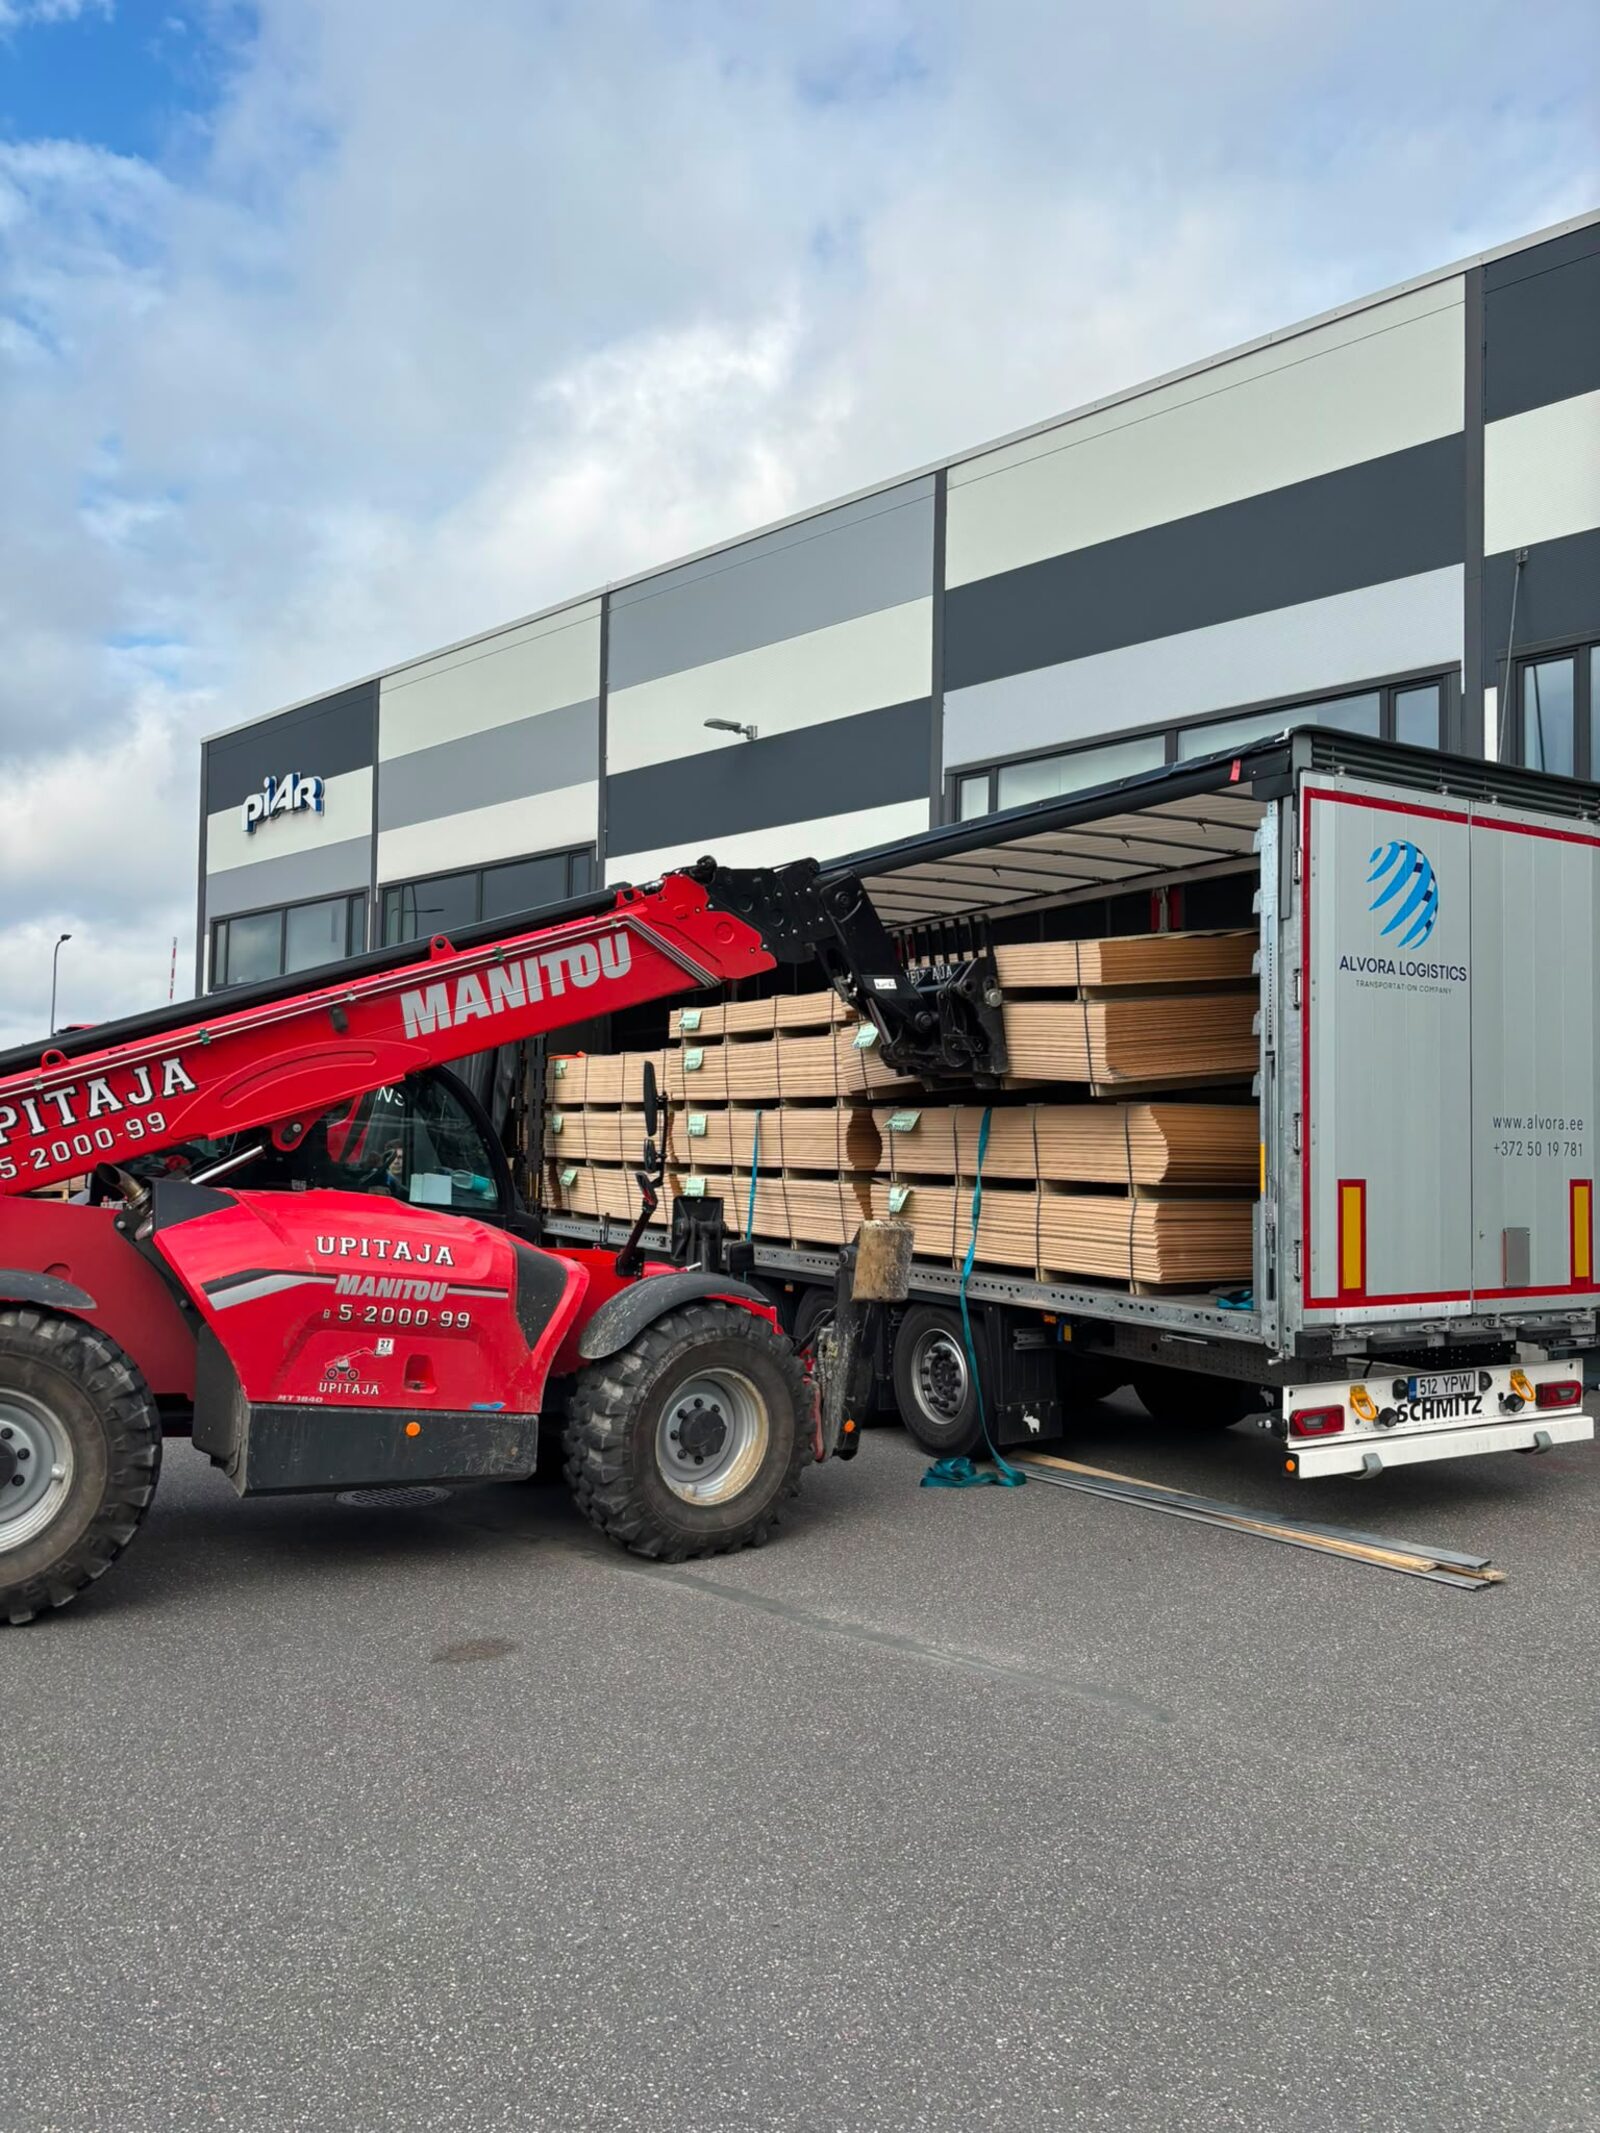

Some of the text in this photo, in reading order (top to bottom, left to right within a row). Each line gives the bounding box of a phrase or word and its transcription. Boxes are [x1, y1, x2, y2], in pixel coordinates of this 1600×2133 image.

[1339, 955, 1467, 982] ALVORA LOGISTICS
[400, 931, 633, 1040] MANITOU
[1419, 985, 1452, 995] COMPANY
[1493, 1114, 1584, 1131] www.alvora.ee
[0, 1111, 167, 1180] 5-2000-99
[1493, 1140, 1583, 1157] +372 50 19 781
[316, 1236, 454, 1266] UPITAJA
[334, 1273, 449, 1303] MANITOU
[338, 1304, 470, 1328] 5-2000-99
[319, 1381, 380, 1396] UPITAJA
[1420, 1374, 1471, 1396] 512 YPW
[1397, 1395, 1483, 1423] SCHMITZ
